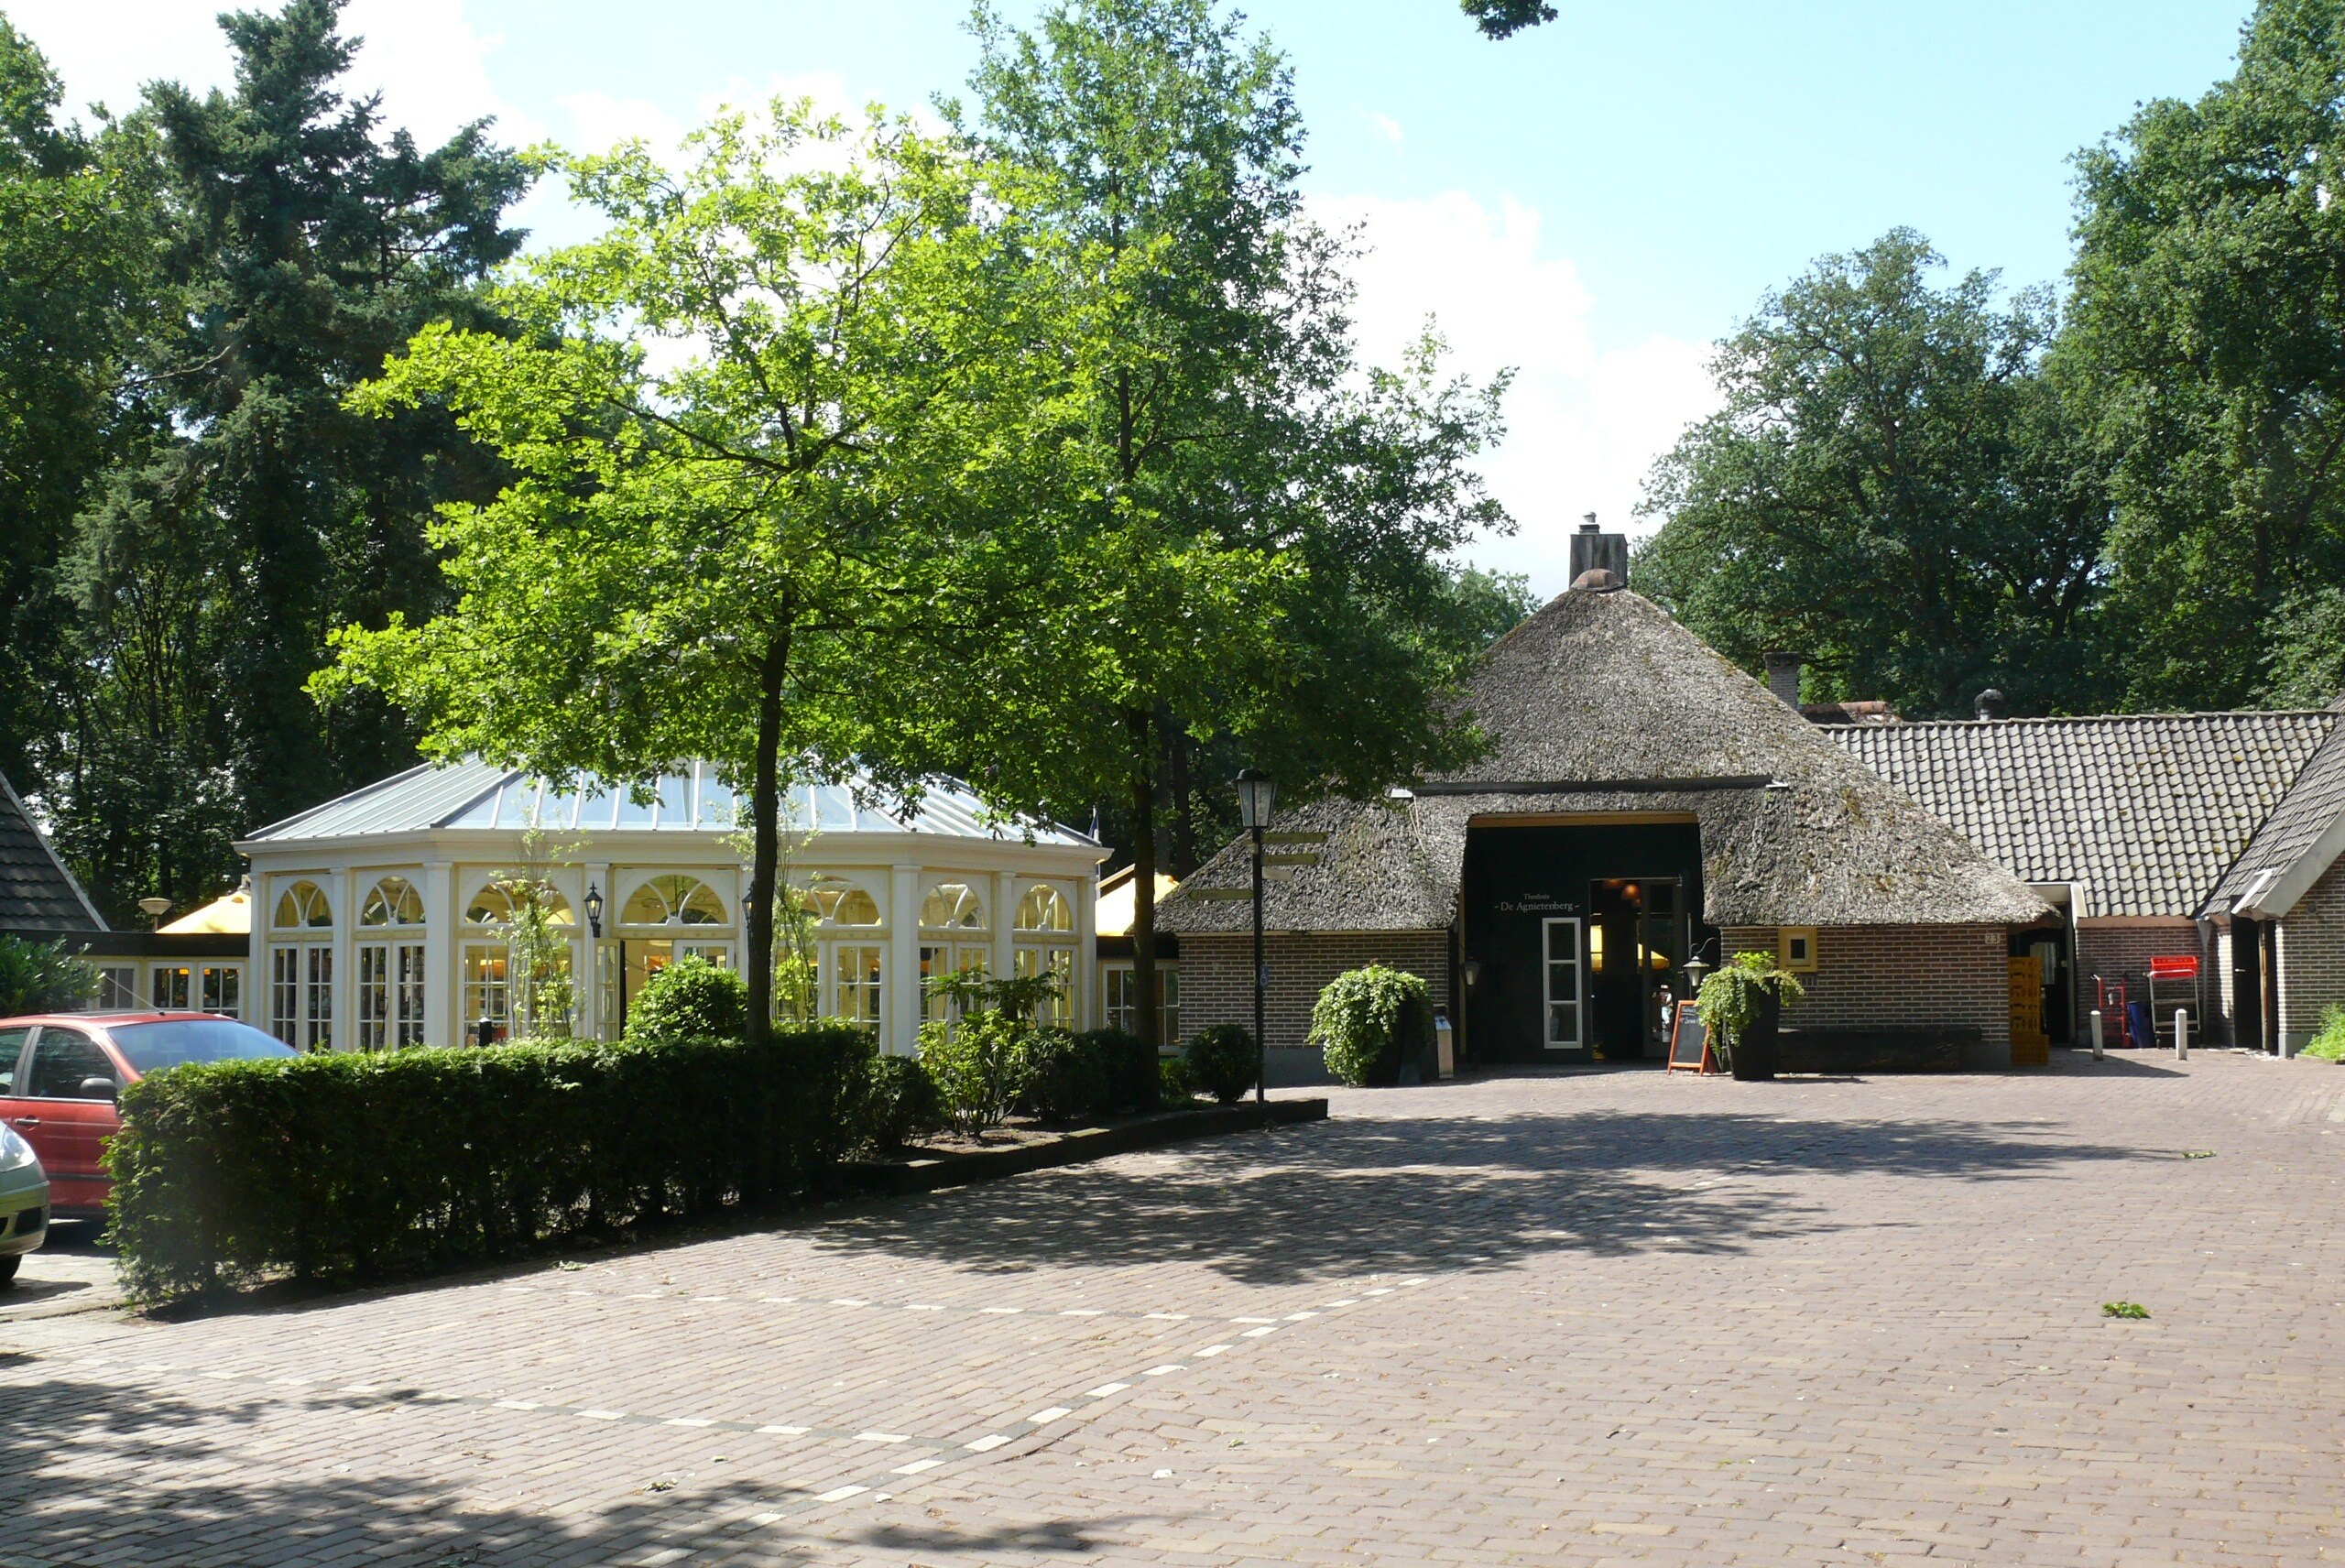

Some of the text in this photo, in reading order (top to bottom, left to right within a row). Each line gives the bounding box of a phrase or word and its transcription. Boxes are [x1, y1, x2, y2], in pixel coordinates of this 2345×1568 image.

[1500, 900, 1574, 913] De Agnietenberg
[1986, 933, 1998, 942] 23
